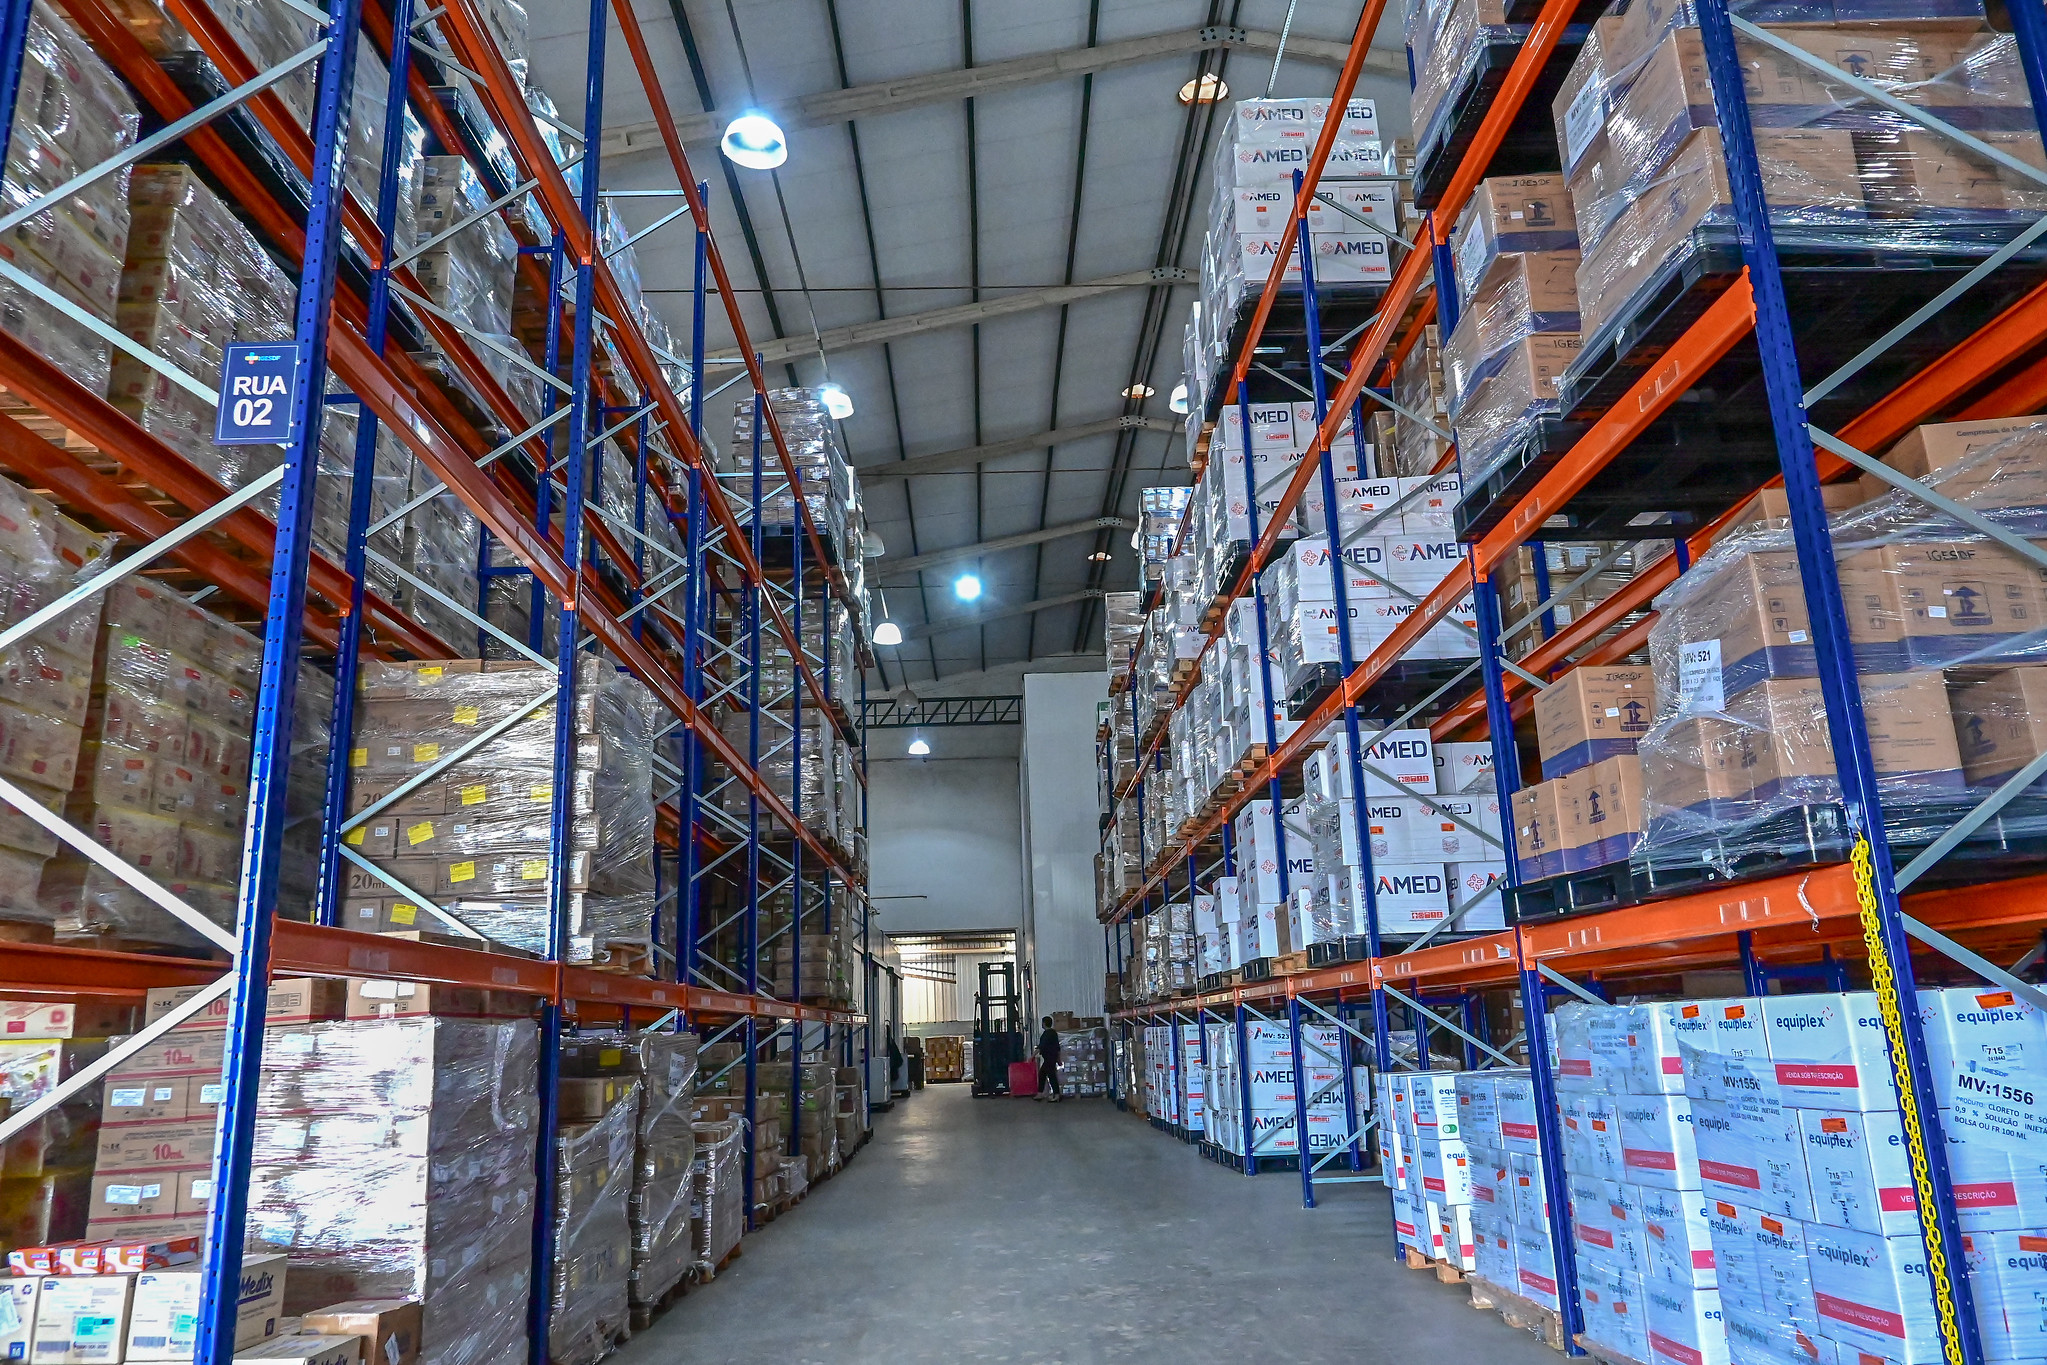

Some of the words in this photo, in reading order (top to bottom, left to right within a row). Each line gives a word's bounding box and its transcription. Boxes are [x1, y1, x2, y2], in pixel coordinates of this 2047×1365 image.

[1254, 107, 1304, 121] AMED
[1252, 149, 1303, 163] AMED
[1249, 192, 1281, 202] AMED
[1333, 241, 1384, 255] AMED
[233, 375, 288, 396] RUA
[233, 398, 273, 427] 02
[1351, 485, 1391, 499] AMED
[1926, 550, 1976, 562] IGESDF
[1386, 604, 1418, 617] AME
[1697, 649, 1711, 662] 521
[1361, 740, 1428, 761] AMED
[1375, 875, 1442, 895] AMED
[207, 998, 229, 1016] 10m
[1776, 1013, 1826, 1031] equiplex
[1956, 1008, 2025, 1028] equiplex
[1677, 1020, 1708, 1034] equiplex
[1718, 1019, 1753, 1032] equiplex
[1262, 1032, 1275, 1040] MV:
[1277, 1033, 1290, 1041] 523
[1319, 1032, 1340, 1041] AME
[1987, 1047, 2004, 1055] 715
[1785, 1071, 1801, 1079] VENDA
[1957, 1076, 2035, 1106] MV:1556
[1586, 1109, 1610, 1121] equiplex
[1987, 1103, 2020, 1118] CLORETO
[2023, 1111, 2034, 1121] DE
[1699, 1114, 1730, 1132] equiple
[1954, 1105, 1966, 1115] 0,9
[1972, 1109, 1979, 1117] %
[2024, 1122, 2047, 1135] INJETÁ
[1954, 1115, 1977, 1127] BOLSA
[1978, 1121, 1990, 1130] OU
[1991, 1124, 2001, 1133] FR
[2002, 1127, 2015, 1137] 100
[2015, 1130, 2027, 1141] ML
[1809, 1133, 1854, 1148] equiplex
[1828, 1172, 1840, 1180] 715
[1952, 1189, 1997, 1203] RESCRIÇÃO
[1710, 1219, 1744, 1236] equiplex
[1818, 1245, 1870, 1268] equiplex
[2007, 1251, 2047, 1273] equi
[240, 1271, 274, 1297] Medix
